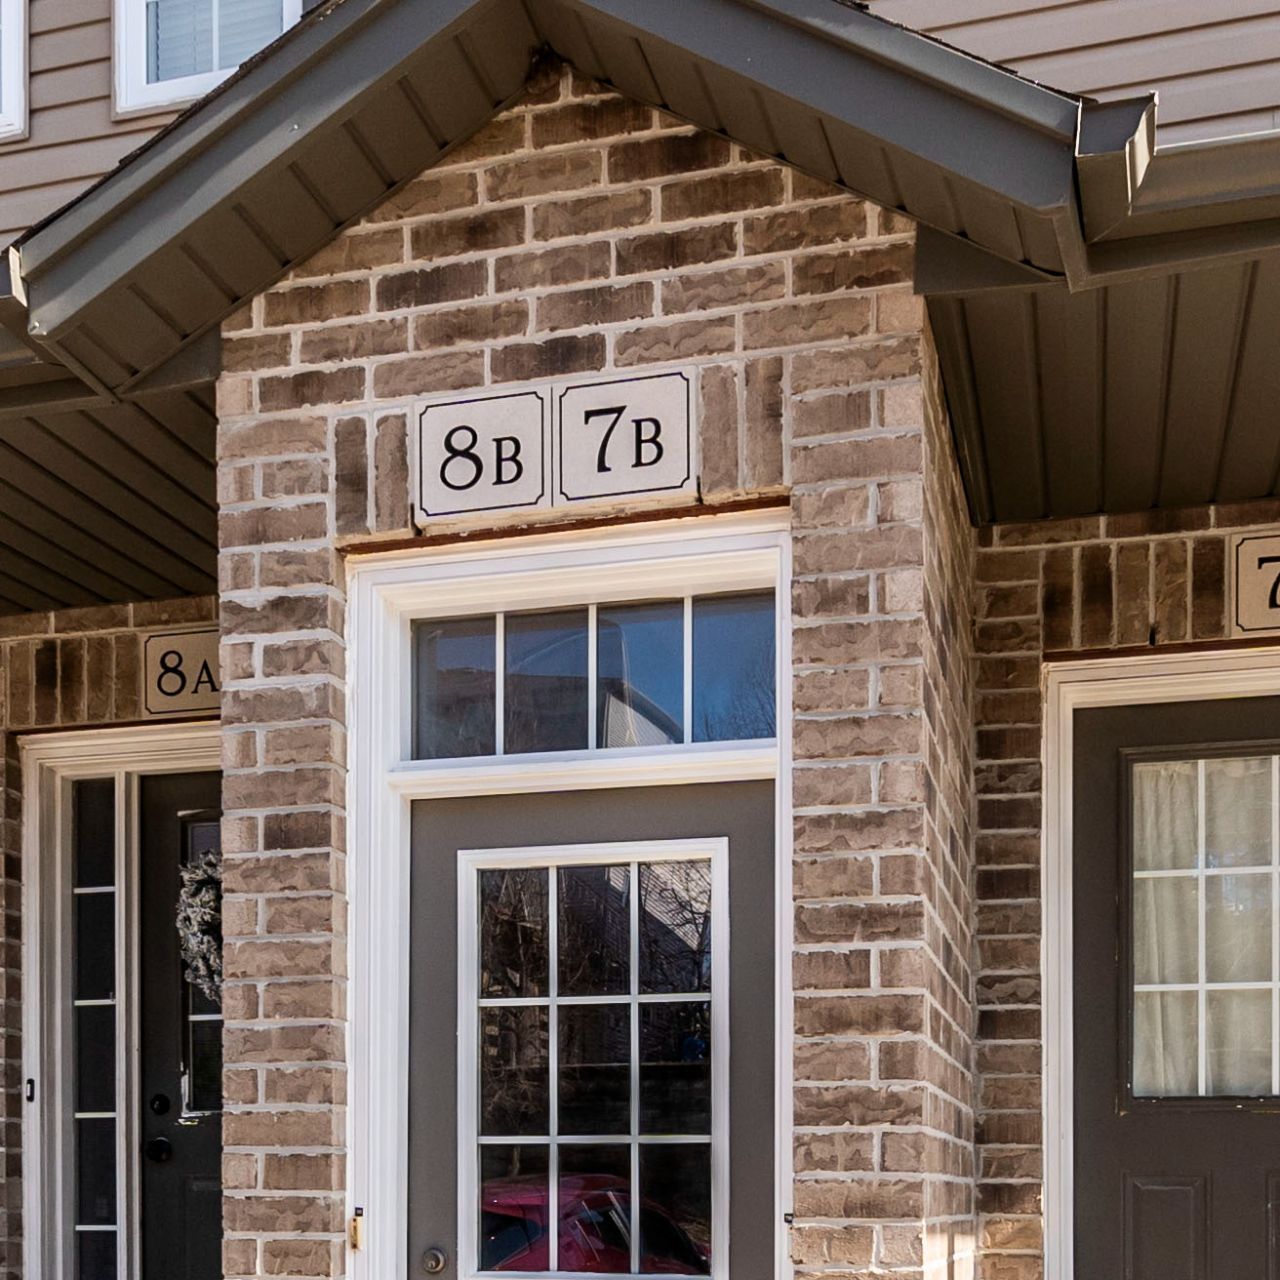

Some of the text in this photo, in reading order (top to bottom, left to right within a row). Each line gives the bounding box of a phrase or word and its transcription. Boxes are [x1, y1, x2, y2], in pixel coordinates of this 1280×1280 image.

[439, 425, 523, 490] 8B
[584, 405, 664, 473] 7B
[157, 650, 220, 696] 8A
